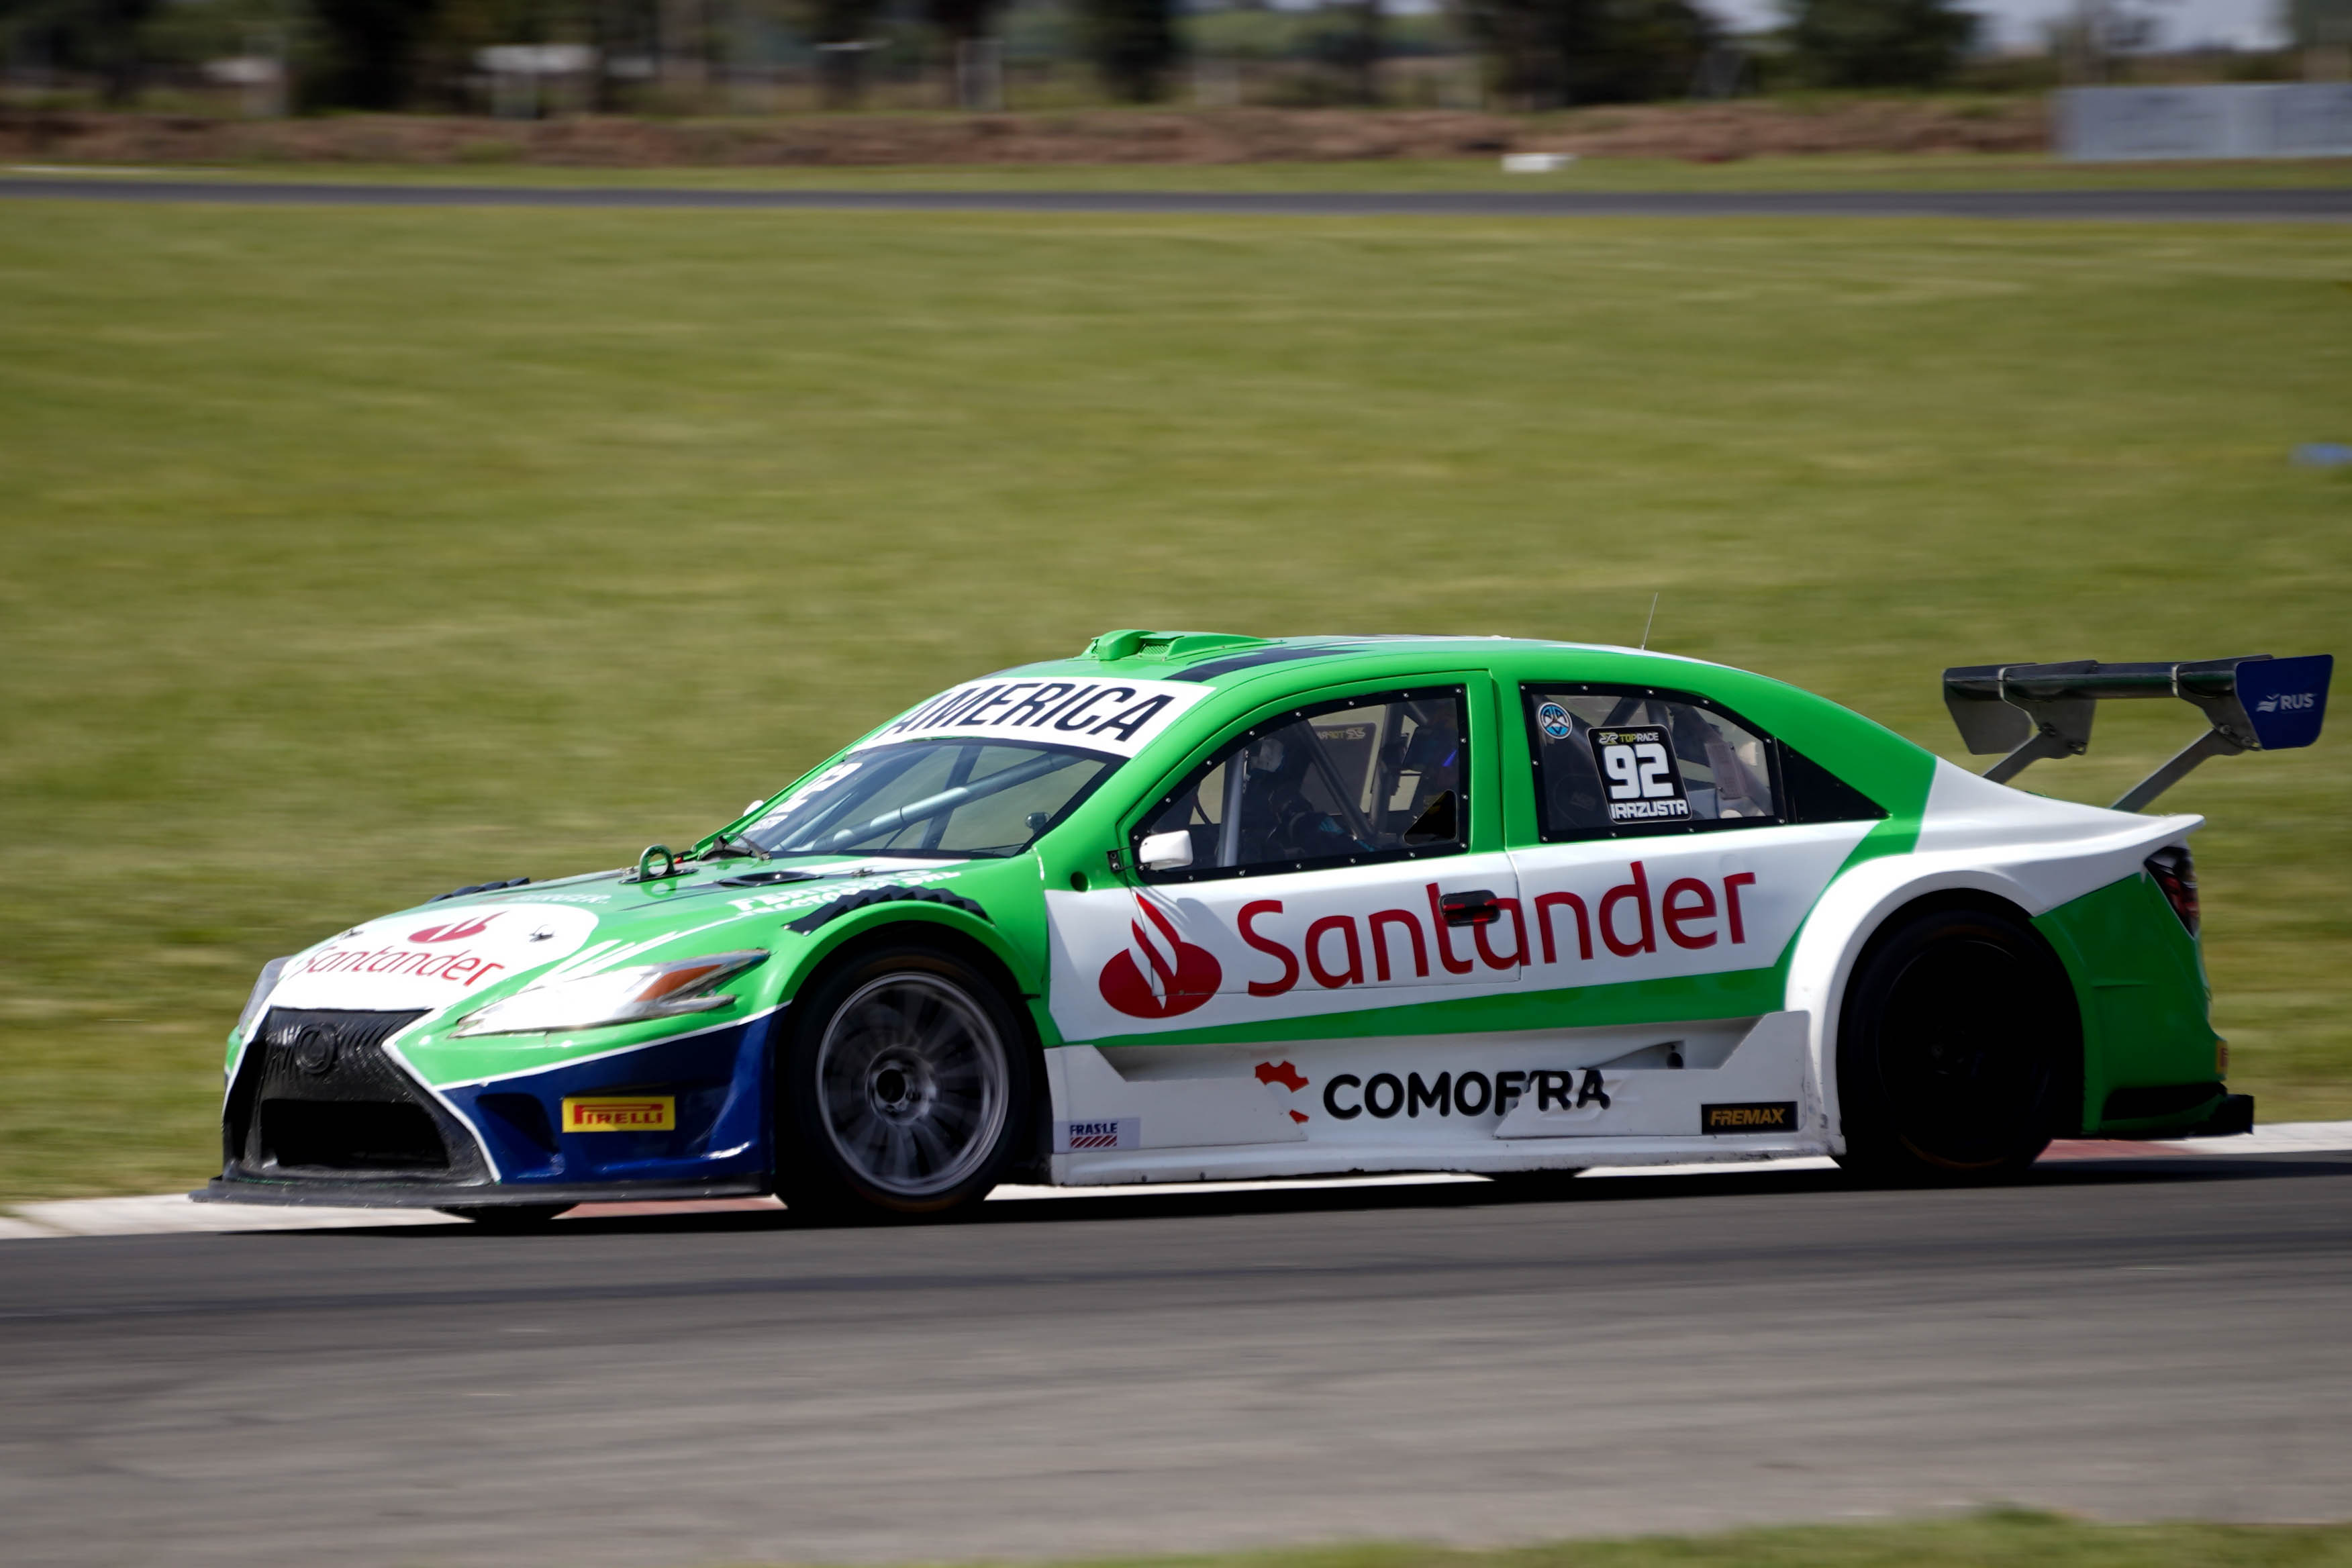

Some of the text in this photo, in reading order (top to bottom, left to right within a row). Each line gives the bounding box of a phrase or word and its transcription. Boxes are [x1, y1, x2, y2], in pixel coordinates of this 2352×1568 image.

[875, 683, 1176, 742] AMERICA
[2280, 693, 2314, 709] RUS
[1604, 743, 1674, 799] 92
[1610, 799, 1688, 819] IRAZUSTA
[1237, 861, 1755, 997] Santander
[287, 945, 505, 987] Santander
[573, 1103, 664, 1124] PIRELLI
[1322, 1069, 1611, 1120] COMOFRA
[1710, 1108, 1785, 1126] FREMAX
